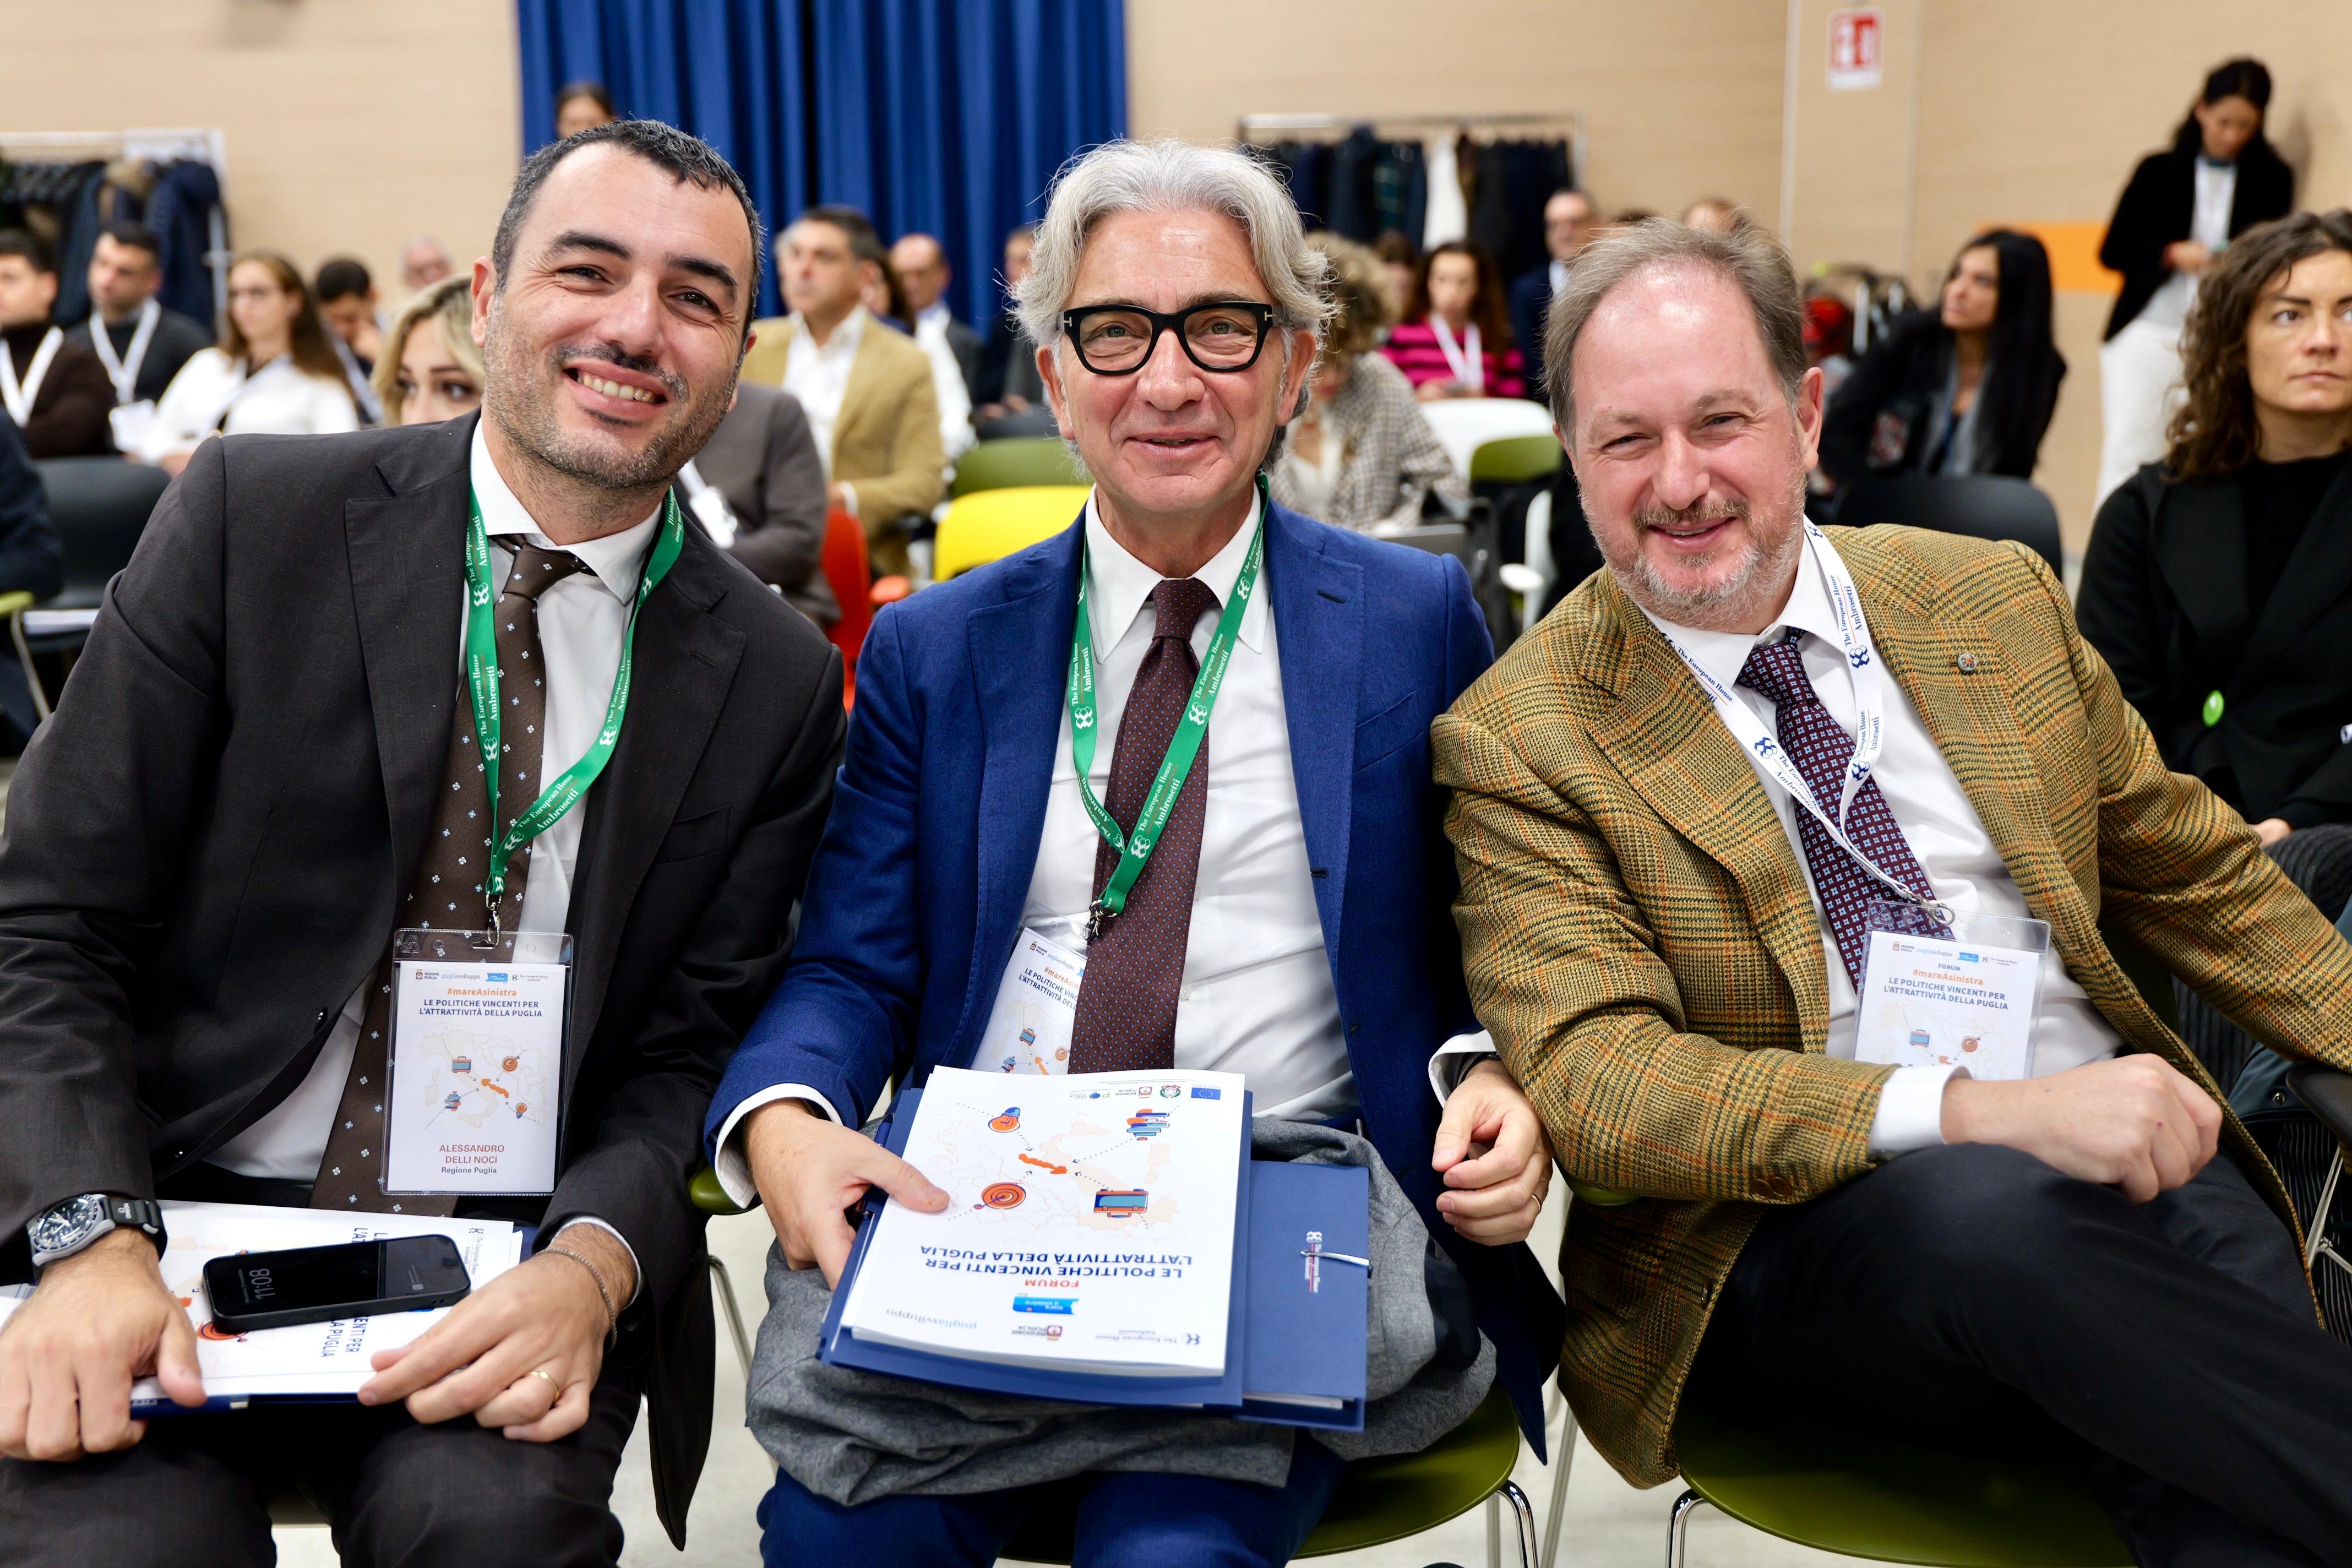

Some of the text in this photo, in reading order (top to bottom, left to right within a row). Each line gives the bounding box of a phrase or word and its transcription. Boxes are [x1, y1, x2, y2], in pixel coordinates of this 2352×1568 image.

[472, 515, 487, 566] Ambrosetti
[1830, 575, 1839, 595] House
[1838, 597, 1848, 631] European
[1844, 586, 1863, 630] Ambrosetti
[1071, 662, 1080, 690] European
[1082, 647, 1092, 692] Ambrosetti
[1194, 633, 1223, 699] The European House
[1208, 650, 1229, 697] Ambrosetti
[1678, 646, 1733, 702] The European House
[476, 680, 485, 718] European
[486, 666, 497, 720] Ambrosetti
[1869, 716, 1880, 751] Ambrosetti
[1779, 754, 1789, 767] The
[517, 775, 574, 827] The European House
[1082, 776, 1110, 822] Ambrosetti
[1137, 761, 1173, 831] The European House
[1154, 778, 1181, 829] Ambrosetti
[1775, 771, 1813, 809] Ambrosetti
[536, 788, 579, 830] Ambrosetti
[1082, 794, 1101, 826] European
[1101, 826, 1111, 839] The
[1104, 897, 1113, 907] use
[1047, 953, 1075, 970] pugliasviluppo
[1917, 948, 1953, 957] pugliasviluppo
[1025, 968, 1033, 976] LE
[1032, 972, 1064, 993] POLITICHE
[1901, 978, 1945, 991] POLITICHE
[1947, 986, 1986, 998] VINCENTI
[1989, 992, 2005, 1000] PER
[1913, 969, 1984, 986] #mareAsinistra
[447, 988, 516, 996] #mareAsinistra
[1019, 974, 1077, 1010] L'ATTRATTIVITÀ DELL
[1884, 986, 2008, 1010] L'ATTRATTIVITÀ DELLA PUGLIA
[420, 1008, 482, 1016] L'ATTRATTIVITÀ
[921, 1245, 1192, 1265] L'ATTRATTIVITÀ DELLA PUGLIA
[925, 1259, 1182, 1278] LE POLITICHE VINCENTI PER
[249, 1268, 276, 1299] 11:08
[1024, 1279, 1079, 1287] FORUM
[350, 1317, 369, 1336] ENTI
[886, 1309, 977, 1329] pugliasviluppo
[320, 1329, 343, 1357] PUGLIA
[345, 1338, 363, 1353] PER
